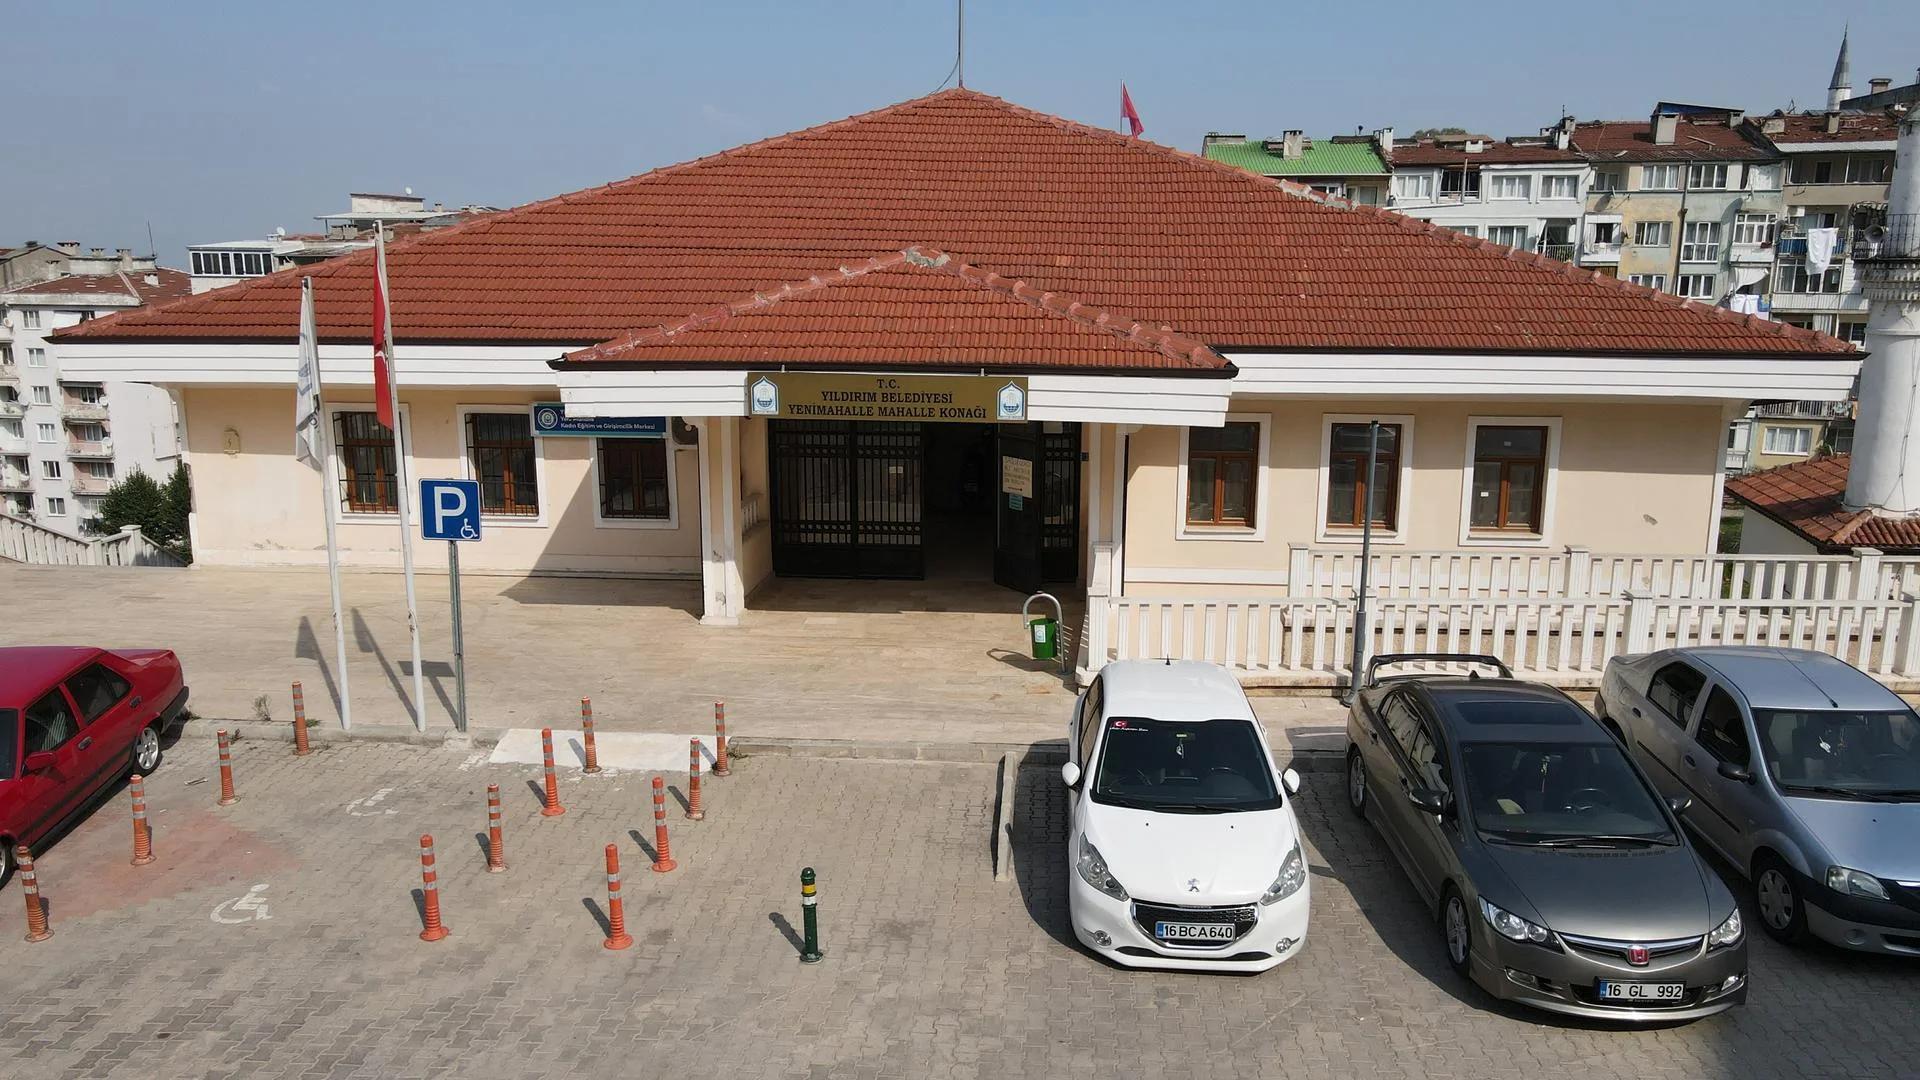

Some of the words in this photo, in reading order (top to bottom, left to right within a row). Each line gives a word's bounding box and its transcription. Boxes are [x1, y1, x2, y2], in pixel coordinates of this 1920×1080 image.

[876, 379, 900, 389] T.C.
[821, 391, 877, 402] YILDIRIM
[881, 390, 953, 404] BELEDİYESİ
[788, 402, 874, 416] YENİMAHALLE
[878, 406, 936, 418] MAHALLE
[939, 405, 987, 419] KONAĞI
[433, 486, 467, 534] P
[1164, 925, 1177, 937] 16
[1178, 926, 1208, 938] BCA
[1209, 927, 1233, 939] 640
[1608, 984, 1621, 996] 16
[1629, 985, 1648, 997] GL
[1657, 985, 1682, 997] 992
